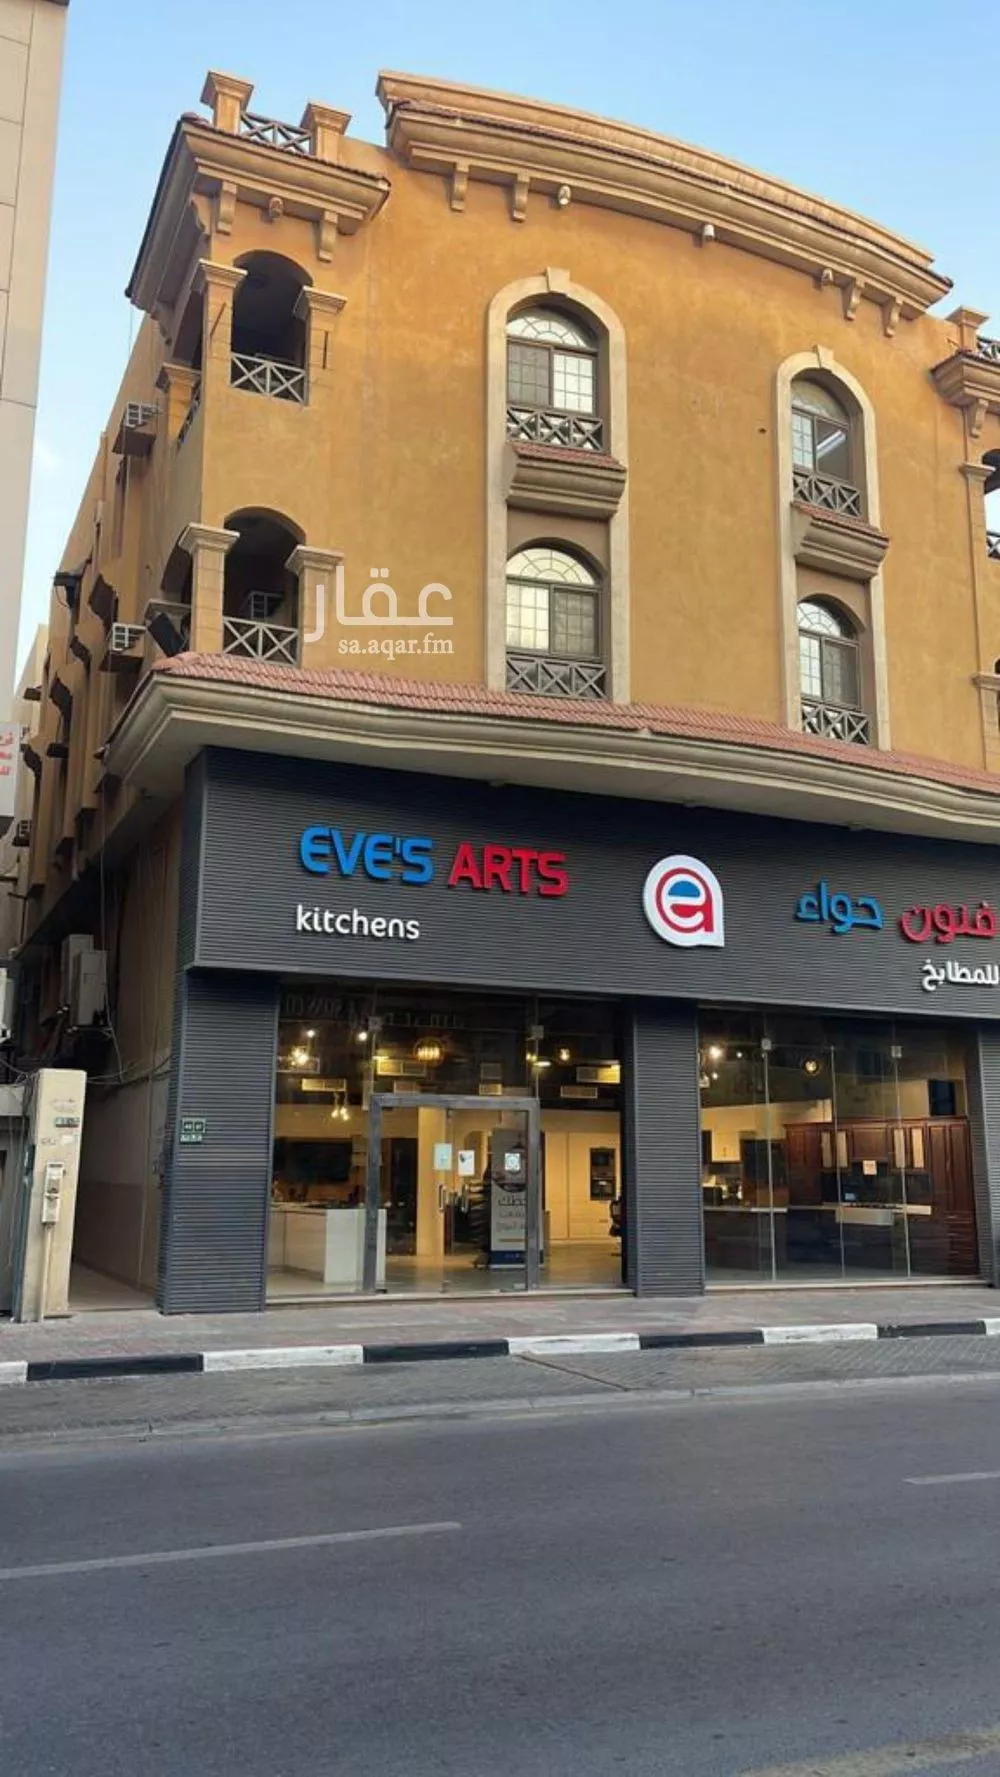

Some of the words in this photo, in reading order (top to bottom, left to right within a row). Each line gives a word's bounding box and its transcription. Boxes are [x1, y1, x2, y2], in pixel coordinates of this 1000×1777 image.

[299, 824, 436, 886] EVE'S
[448, 841, 570, 897] ARTS
[296, 904, 420, 940] kitchens
[796, 878, 884, 933] حواء
[900, 901, 998, 944] فنون
[921, 959, 1000, 991] للمطابخ
